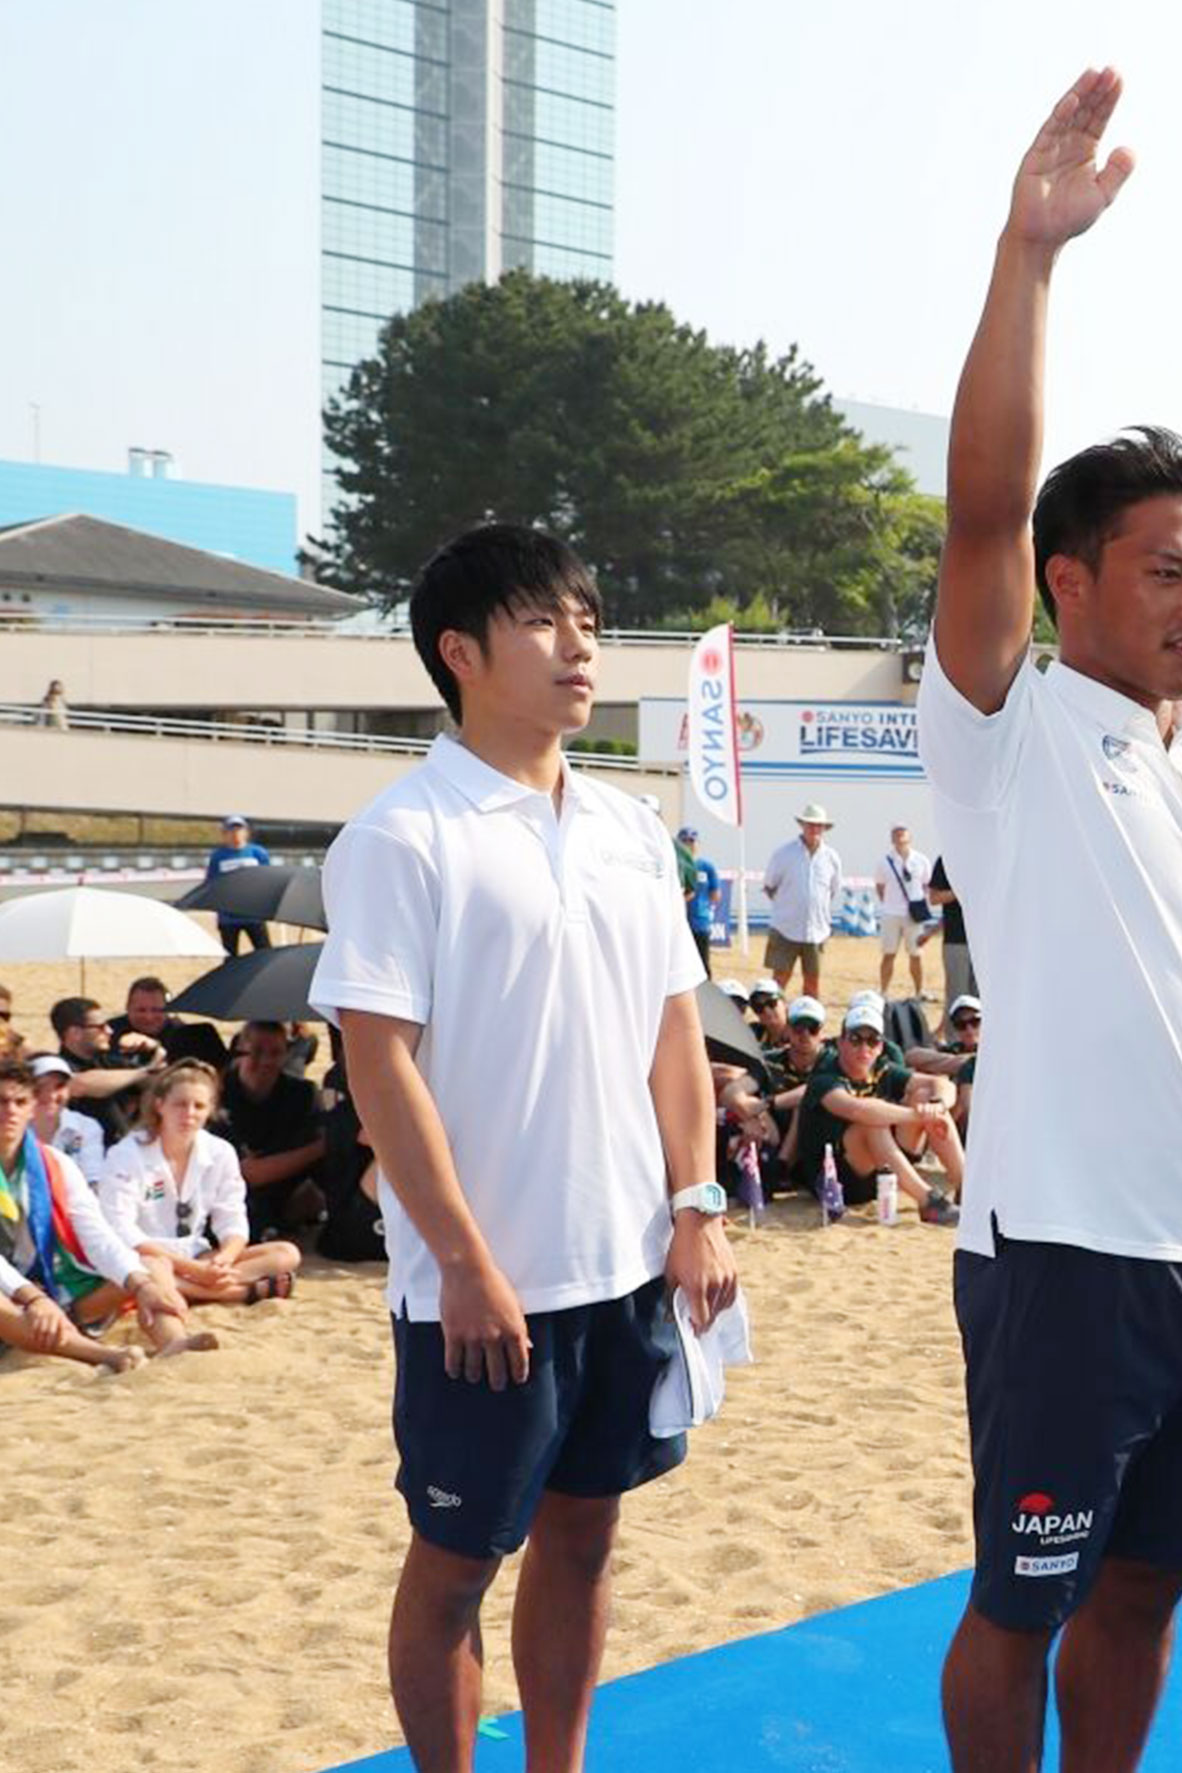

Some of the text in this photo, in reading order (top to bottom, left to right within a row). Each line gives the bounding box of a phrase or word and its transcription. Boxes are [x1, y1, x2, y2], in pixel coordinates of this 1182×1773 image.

[816, 711, 873, 724] SANYO
[1011, 1510, 1093, 1535] JAPAN
[1032, 1558, 1074, 1573] SANYO
